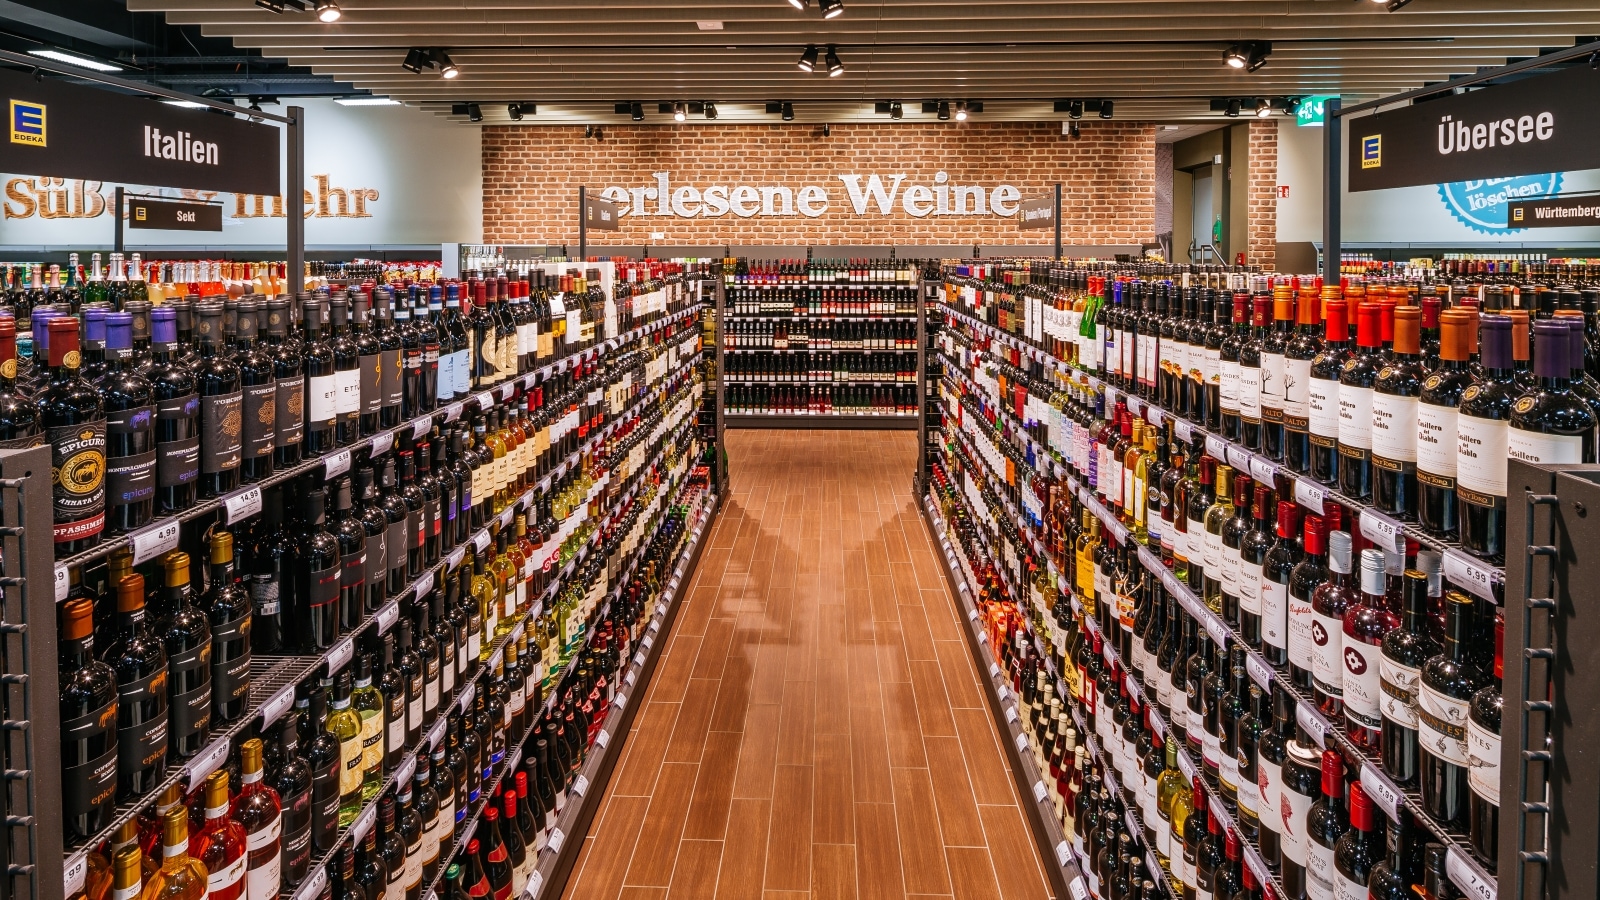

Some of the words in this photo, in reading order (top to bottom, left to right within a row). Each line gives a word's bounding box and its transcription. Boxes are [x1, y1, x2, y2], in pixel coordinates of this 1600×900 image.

[14, 134, 44, 143] EDEKA
[1438, 111, 1554, 155] Übersee
[144, 125, 218, 165] Italien
[601, 170, 829, 218] erlesene
[838, 170, 1021, 218] Weine
[1466, 180, 1544, 212] löschen
[176, 210, 196, 222] Sekt
[1535, 205, 1600, 219] Württemberg
[1418, 432, 1438, 444] Diablo
[58, 438, 104, 455] EPICURO
[1458, 444, 1478, 458] Diablo
[1508, 446, 1540, 462] Casillero
[1420, 710, 1460, 736] MONTES
